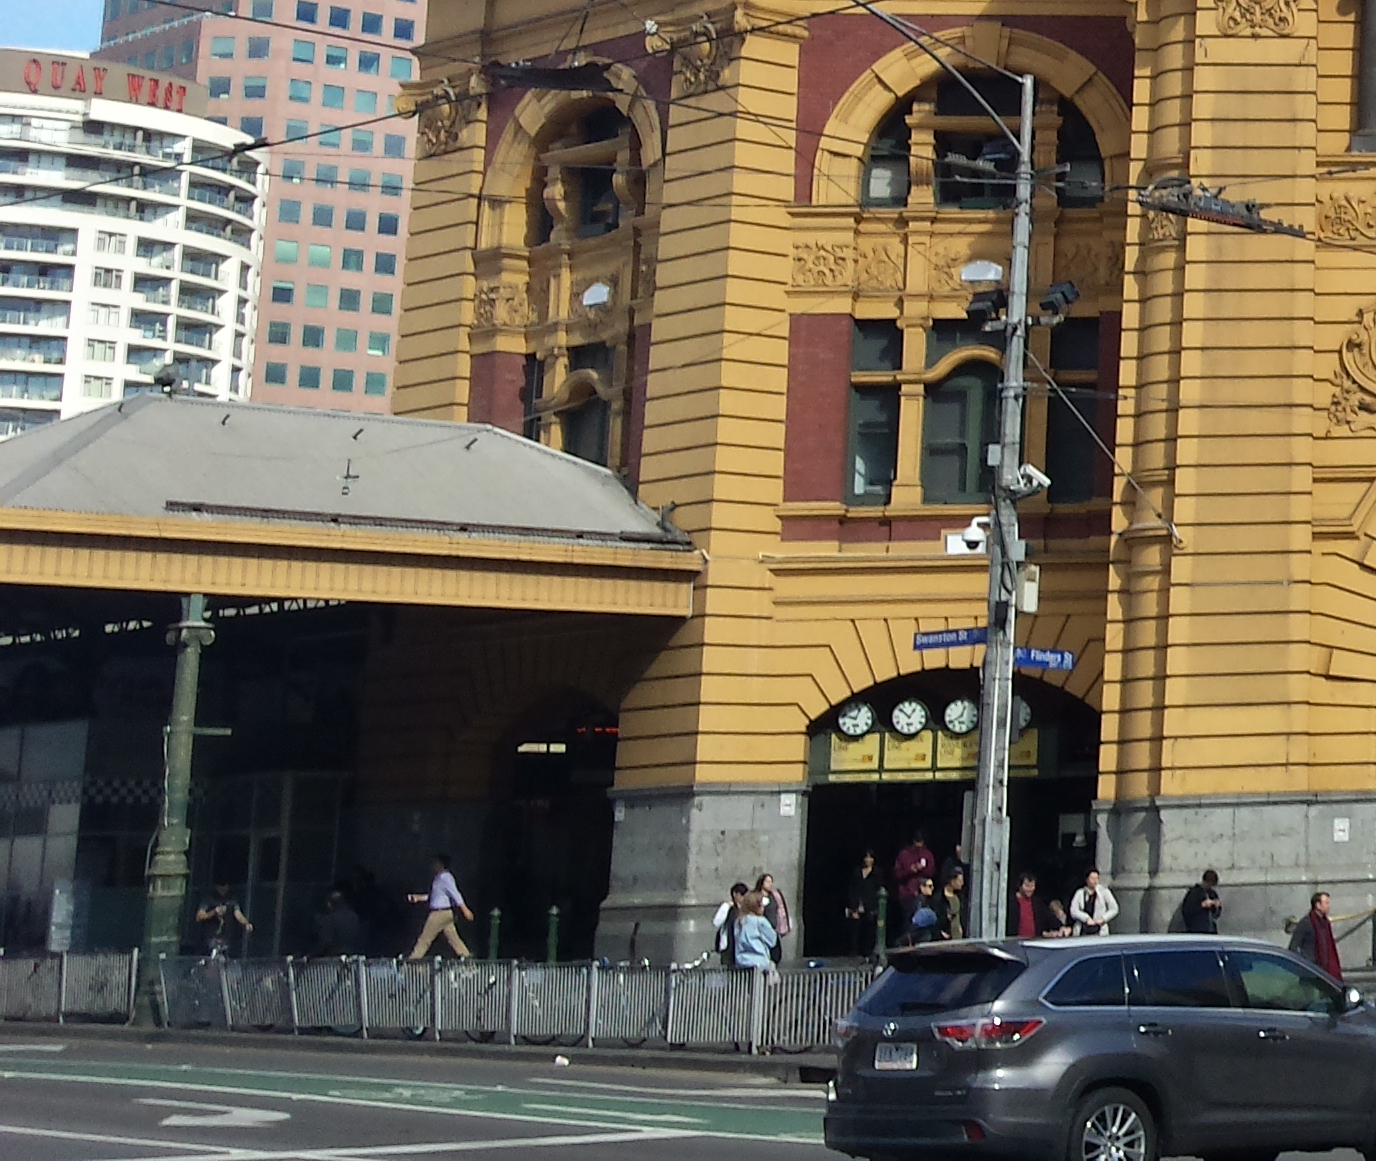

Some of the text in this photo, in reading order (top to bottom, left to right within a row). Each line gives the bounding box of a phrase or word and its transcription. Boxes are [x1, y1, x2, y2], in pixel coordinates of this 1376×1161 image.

[23, 58, 187, 113] QUAY WEST
[915, 630, 968, 645] Swanston St
